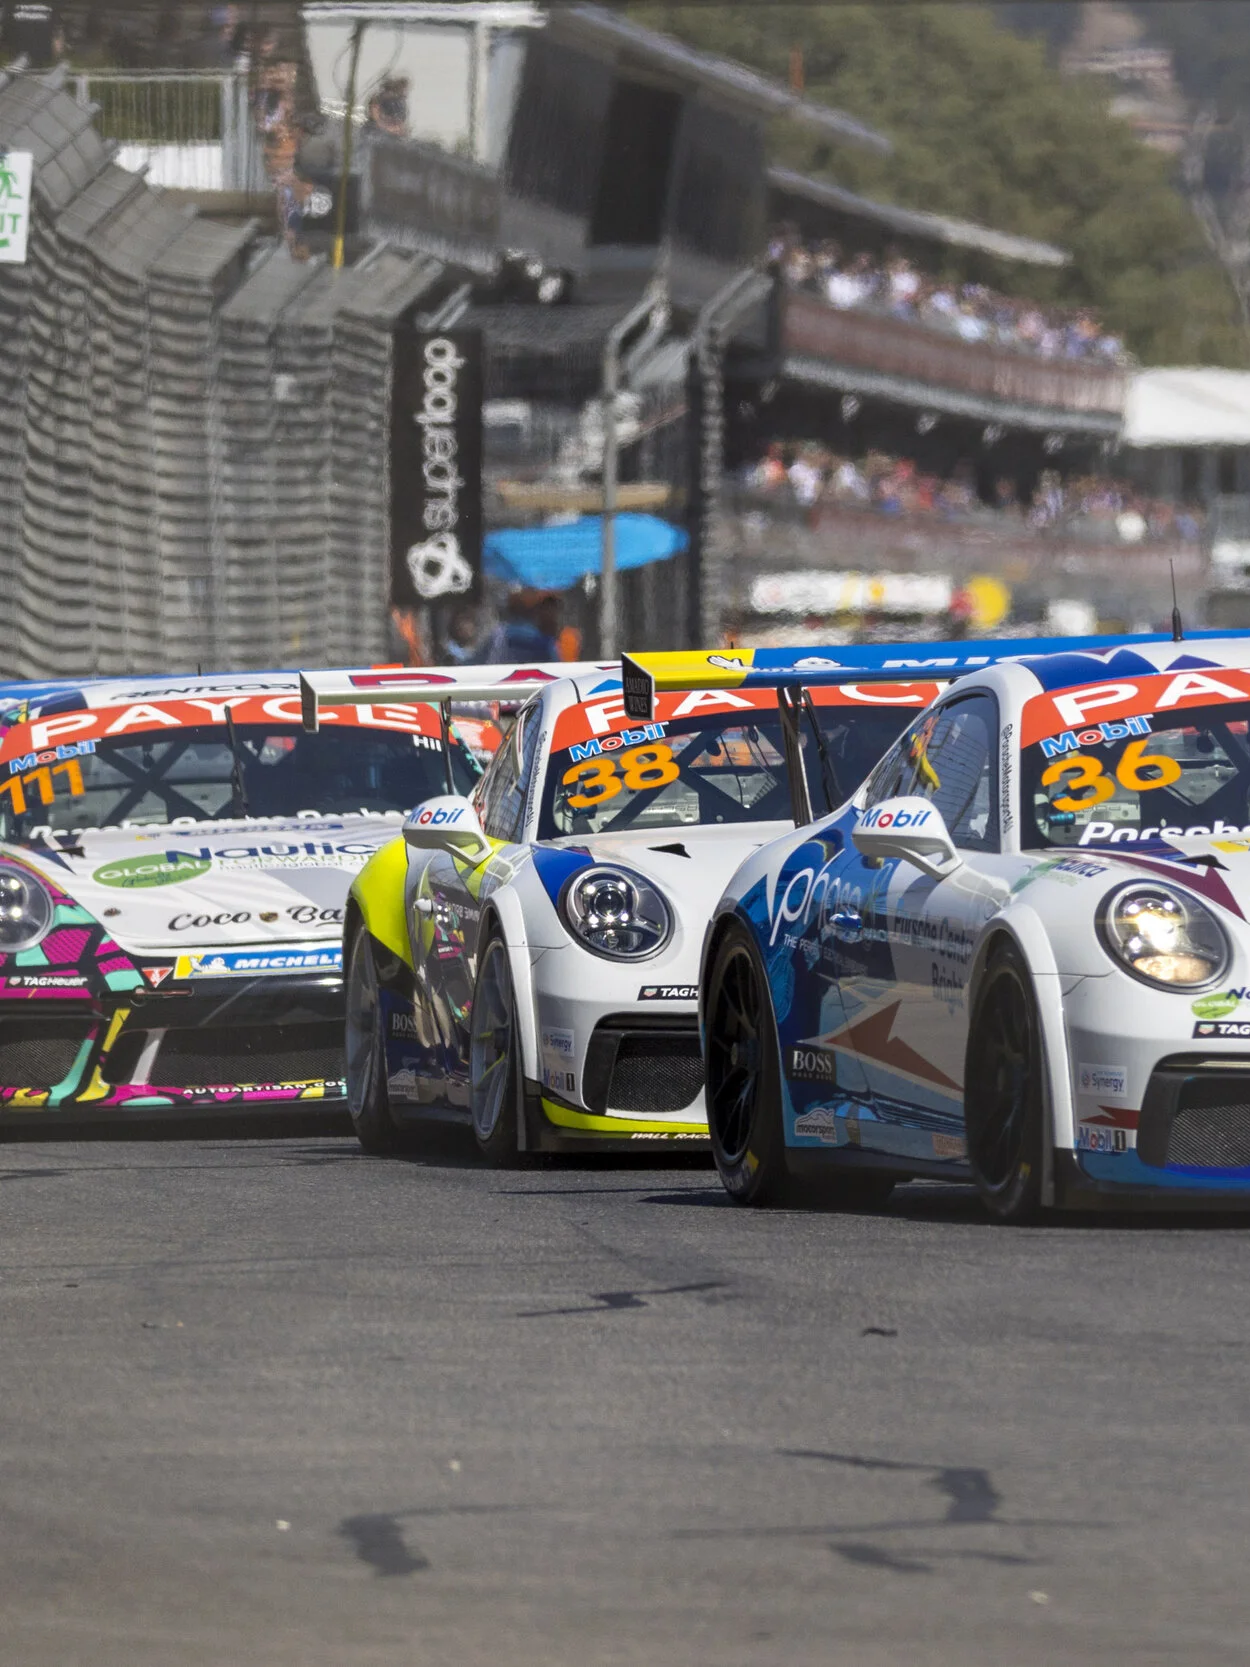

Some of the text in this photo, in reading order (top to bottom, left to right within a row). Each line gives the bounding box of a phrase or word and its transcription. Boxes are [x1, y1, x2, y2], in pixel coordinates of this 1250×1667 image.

[414, 338, 466, 530] superloop
[10, 738, 101, 774] Mobil
[569, 721, 669, 762] Mobil
[1039, 714, 1154, 758] Mobil
[0, 757, 85, 816] 111
[562, 744, 680, 809] 38
[1041, 739, 1182, 812] 36
[410, 807, 465, 825] Mobil
[858, 809, 933, 829] Mobil
[168, 911, 251, 932] Coco
[792, 1050, 832, 1074] BOSS
